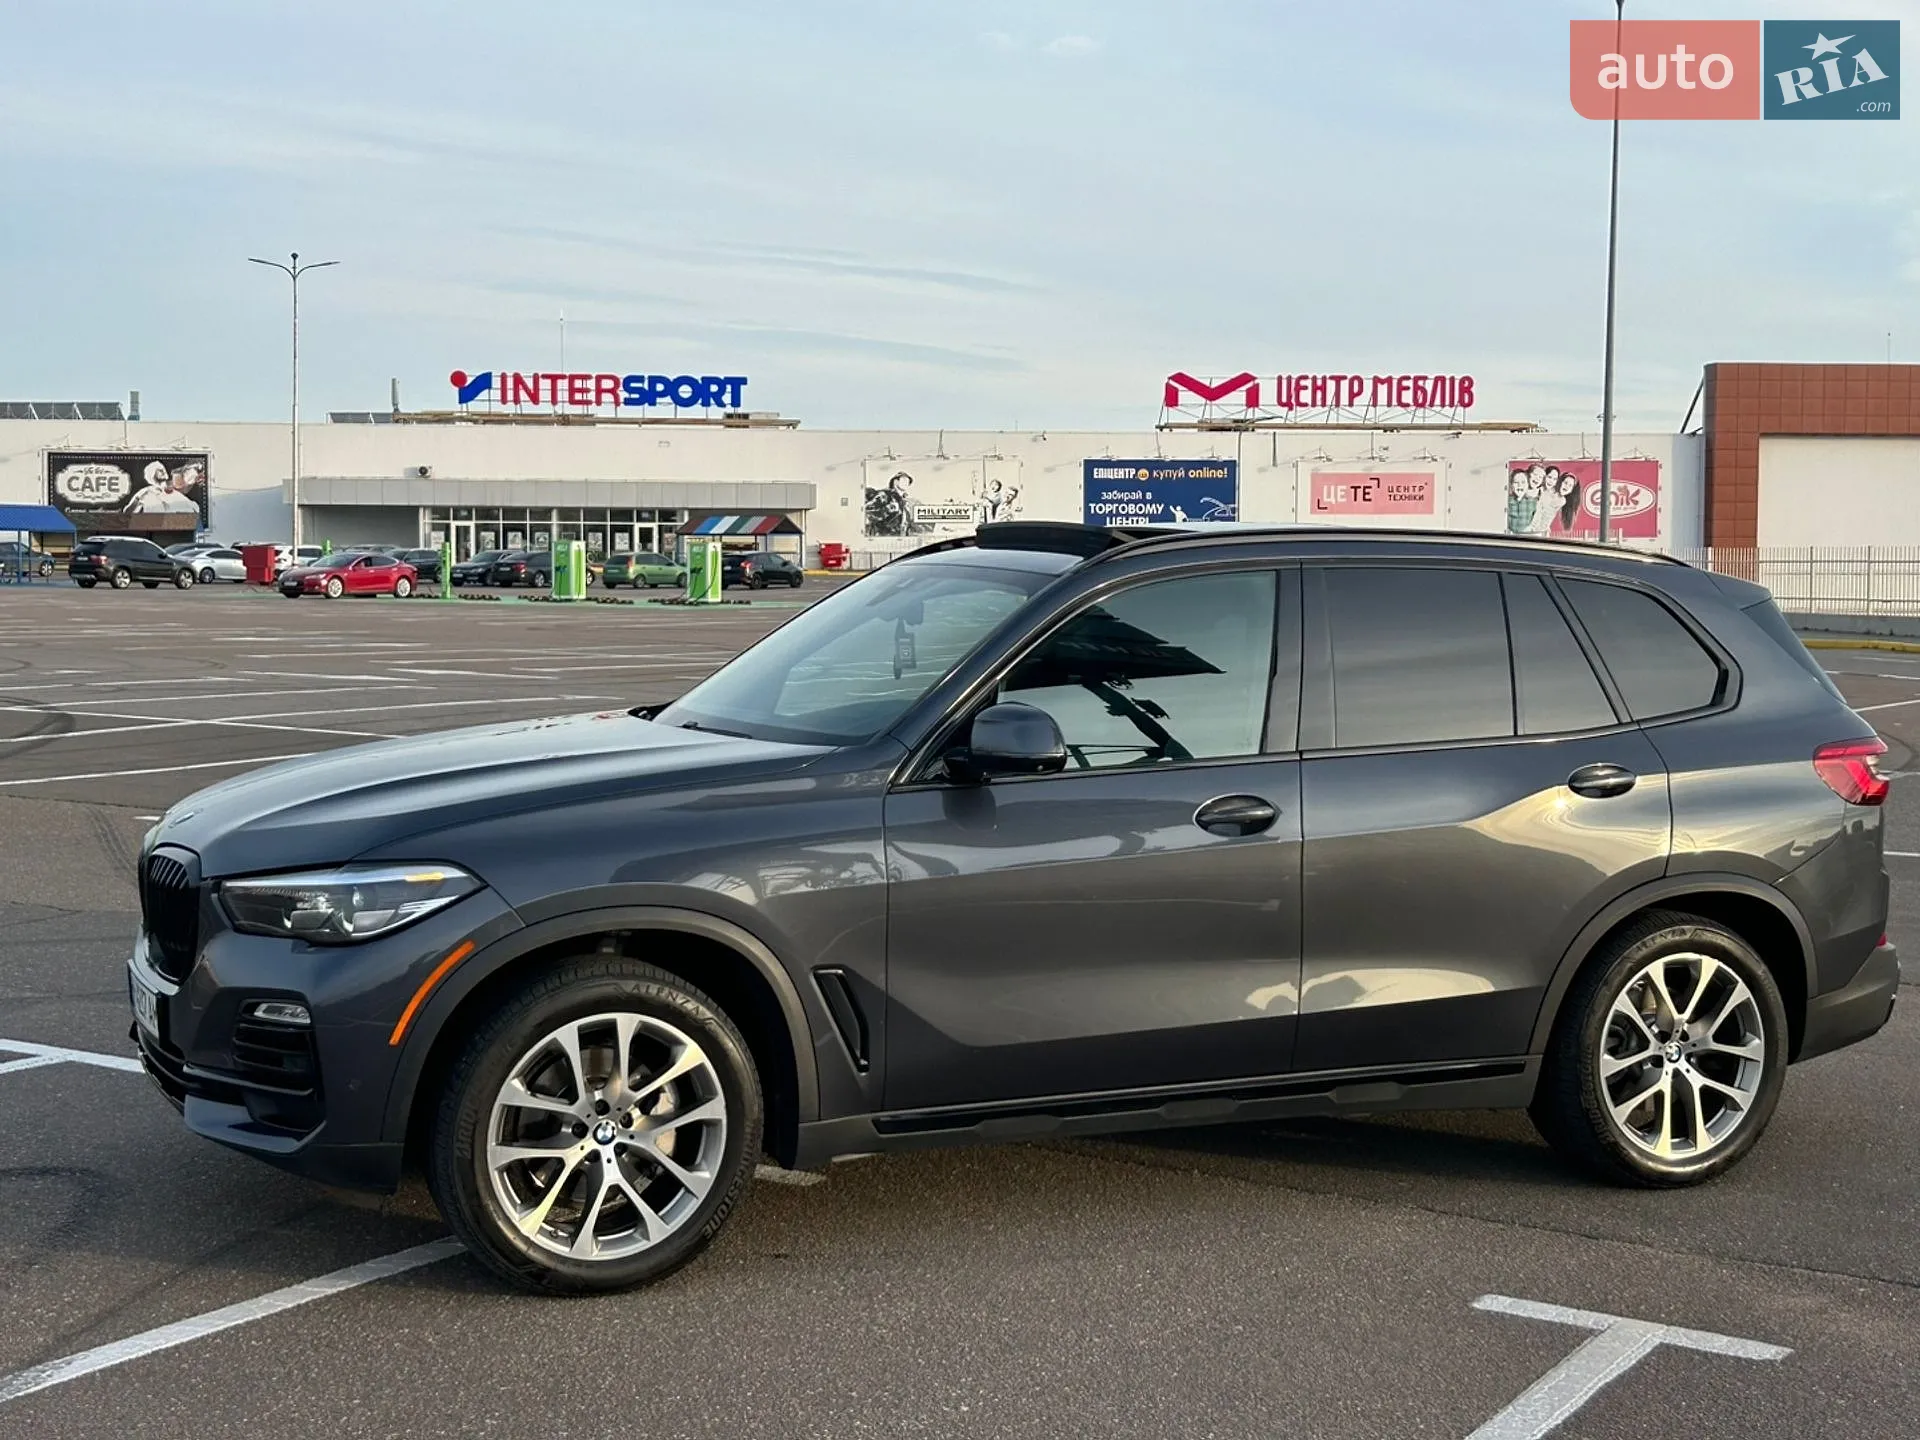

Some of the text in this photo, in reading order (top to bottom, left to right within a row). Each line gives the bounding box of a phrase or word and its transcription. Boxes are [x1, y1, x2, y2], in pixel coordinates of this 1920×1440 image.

[500, 372, 748, 408] INTERSPORT
[1276, 374, 1475, 411] ЦЕНТР МЕБЛІВ
[1153, 468, 1185, 481] купуй
[1188, 467, 1228, 478] online!
[67, 476, 120, 493] CAFE
[1387, 485, 1425, 493] ЦЕНТР
[1101, 490, 1142, 502] забирай
[1089, 503, 1164, 514] ТОРГОВОМУ
